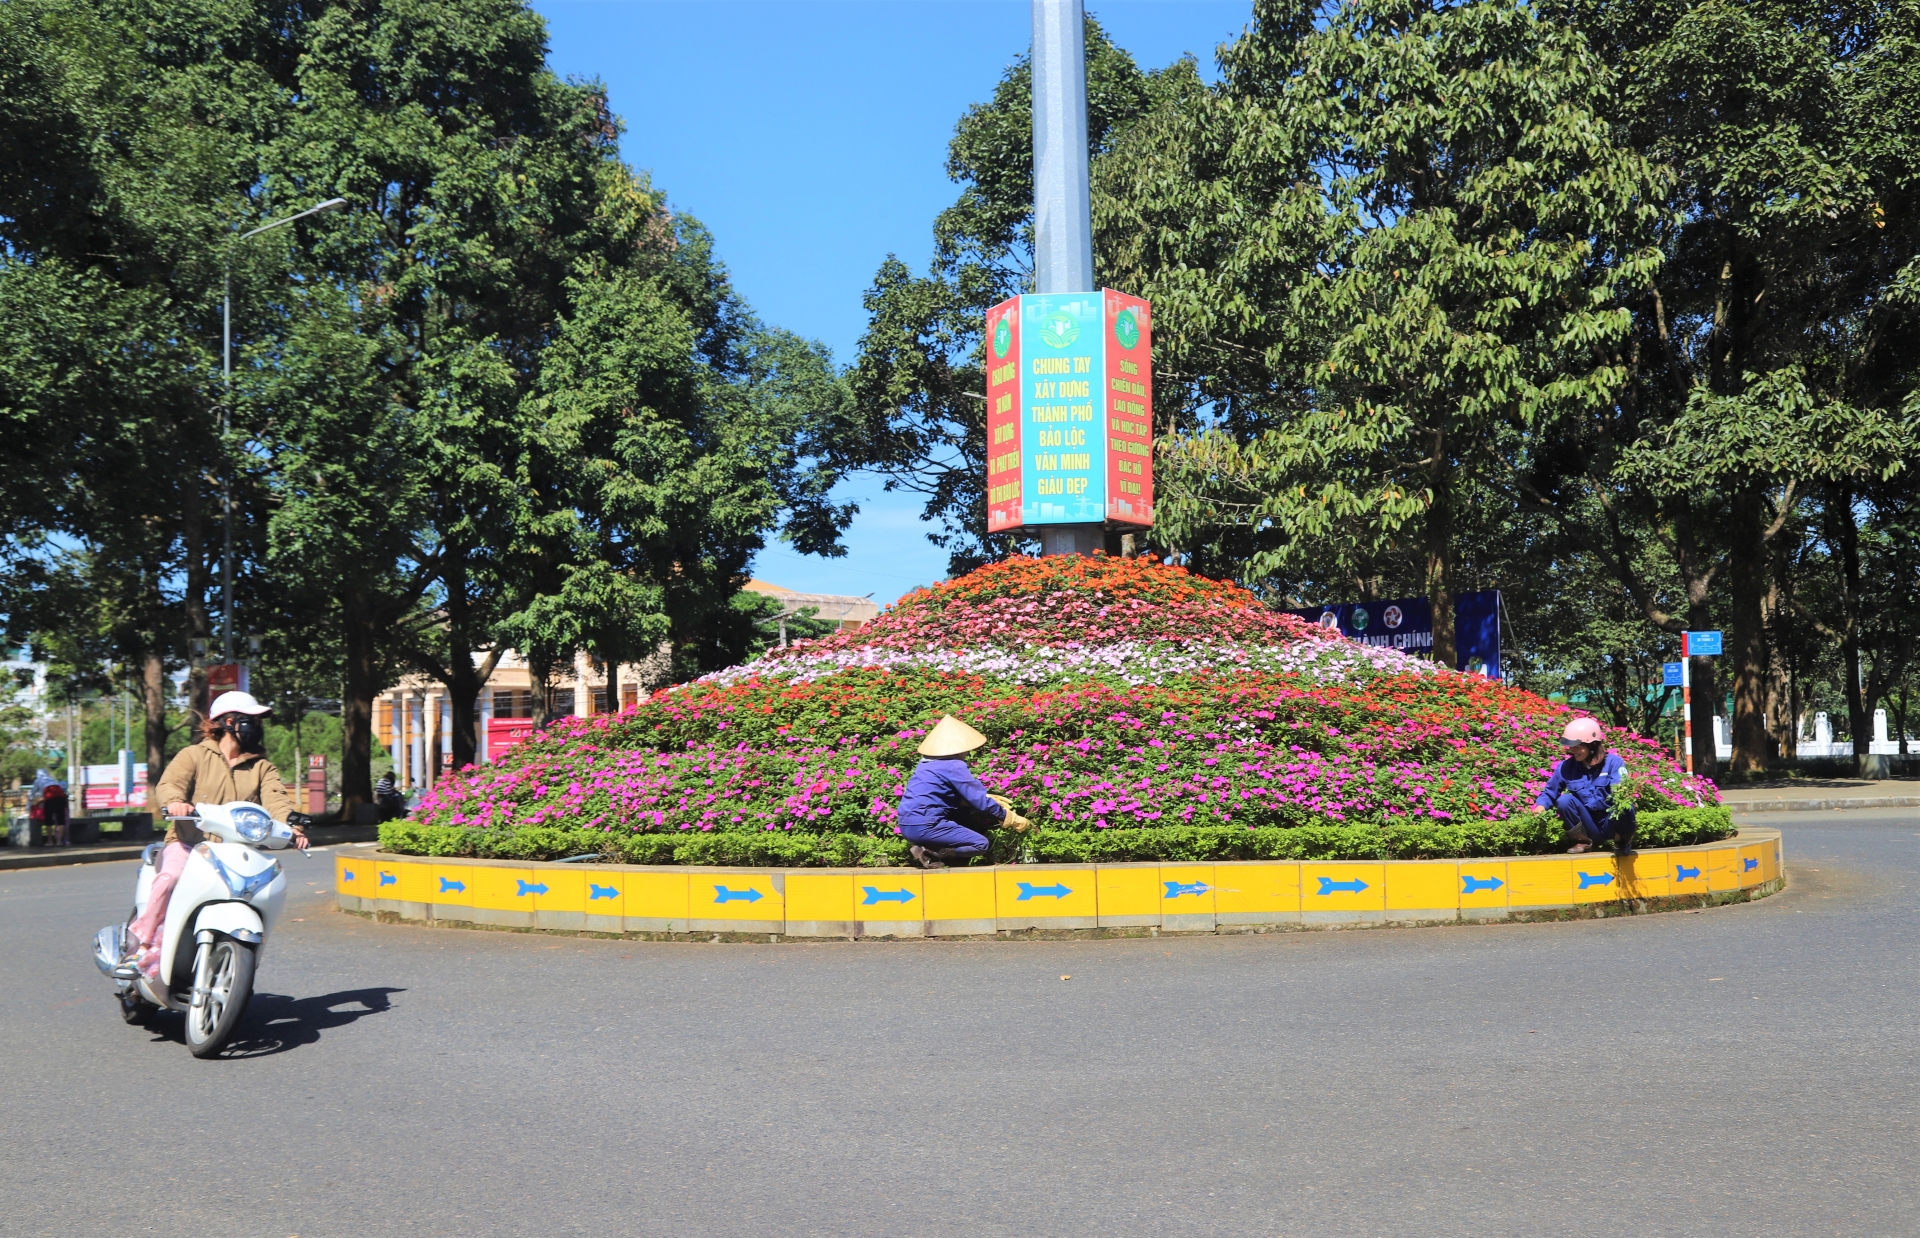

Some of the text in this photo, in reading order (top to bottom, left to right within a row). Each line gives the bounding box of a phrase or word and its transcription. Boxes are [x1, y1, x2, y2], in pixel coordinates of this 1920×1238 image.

[1033, 356, 1091, 375] CHUNG TAY
[1120, 357, 1138, 376] SỐNG
[1034, 379, 1089, 401] XÂY DỰNG
[1112, 377, 1130, 394] CHIẾN
[1031, 398, 1093, 422] THÀNH PHỐ
[1114, 398, 1145, 418] LAO ĐỘNG
[1039, 425, 1085, 450] BẢO LỘC
[1111, 417, 1148, 438] VÀ HỌC TẬP
[1110, 437, 1149, 457] THEO GƯƠNG
[1035, 450, 1090, 471] VĂN MINH
[1119, 458, 1132, 474] BÁC
[1038, 474, 1088, 498] GIÀU ĐẸP
